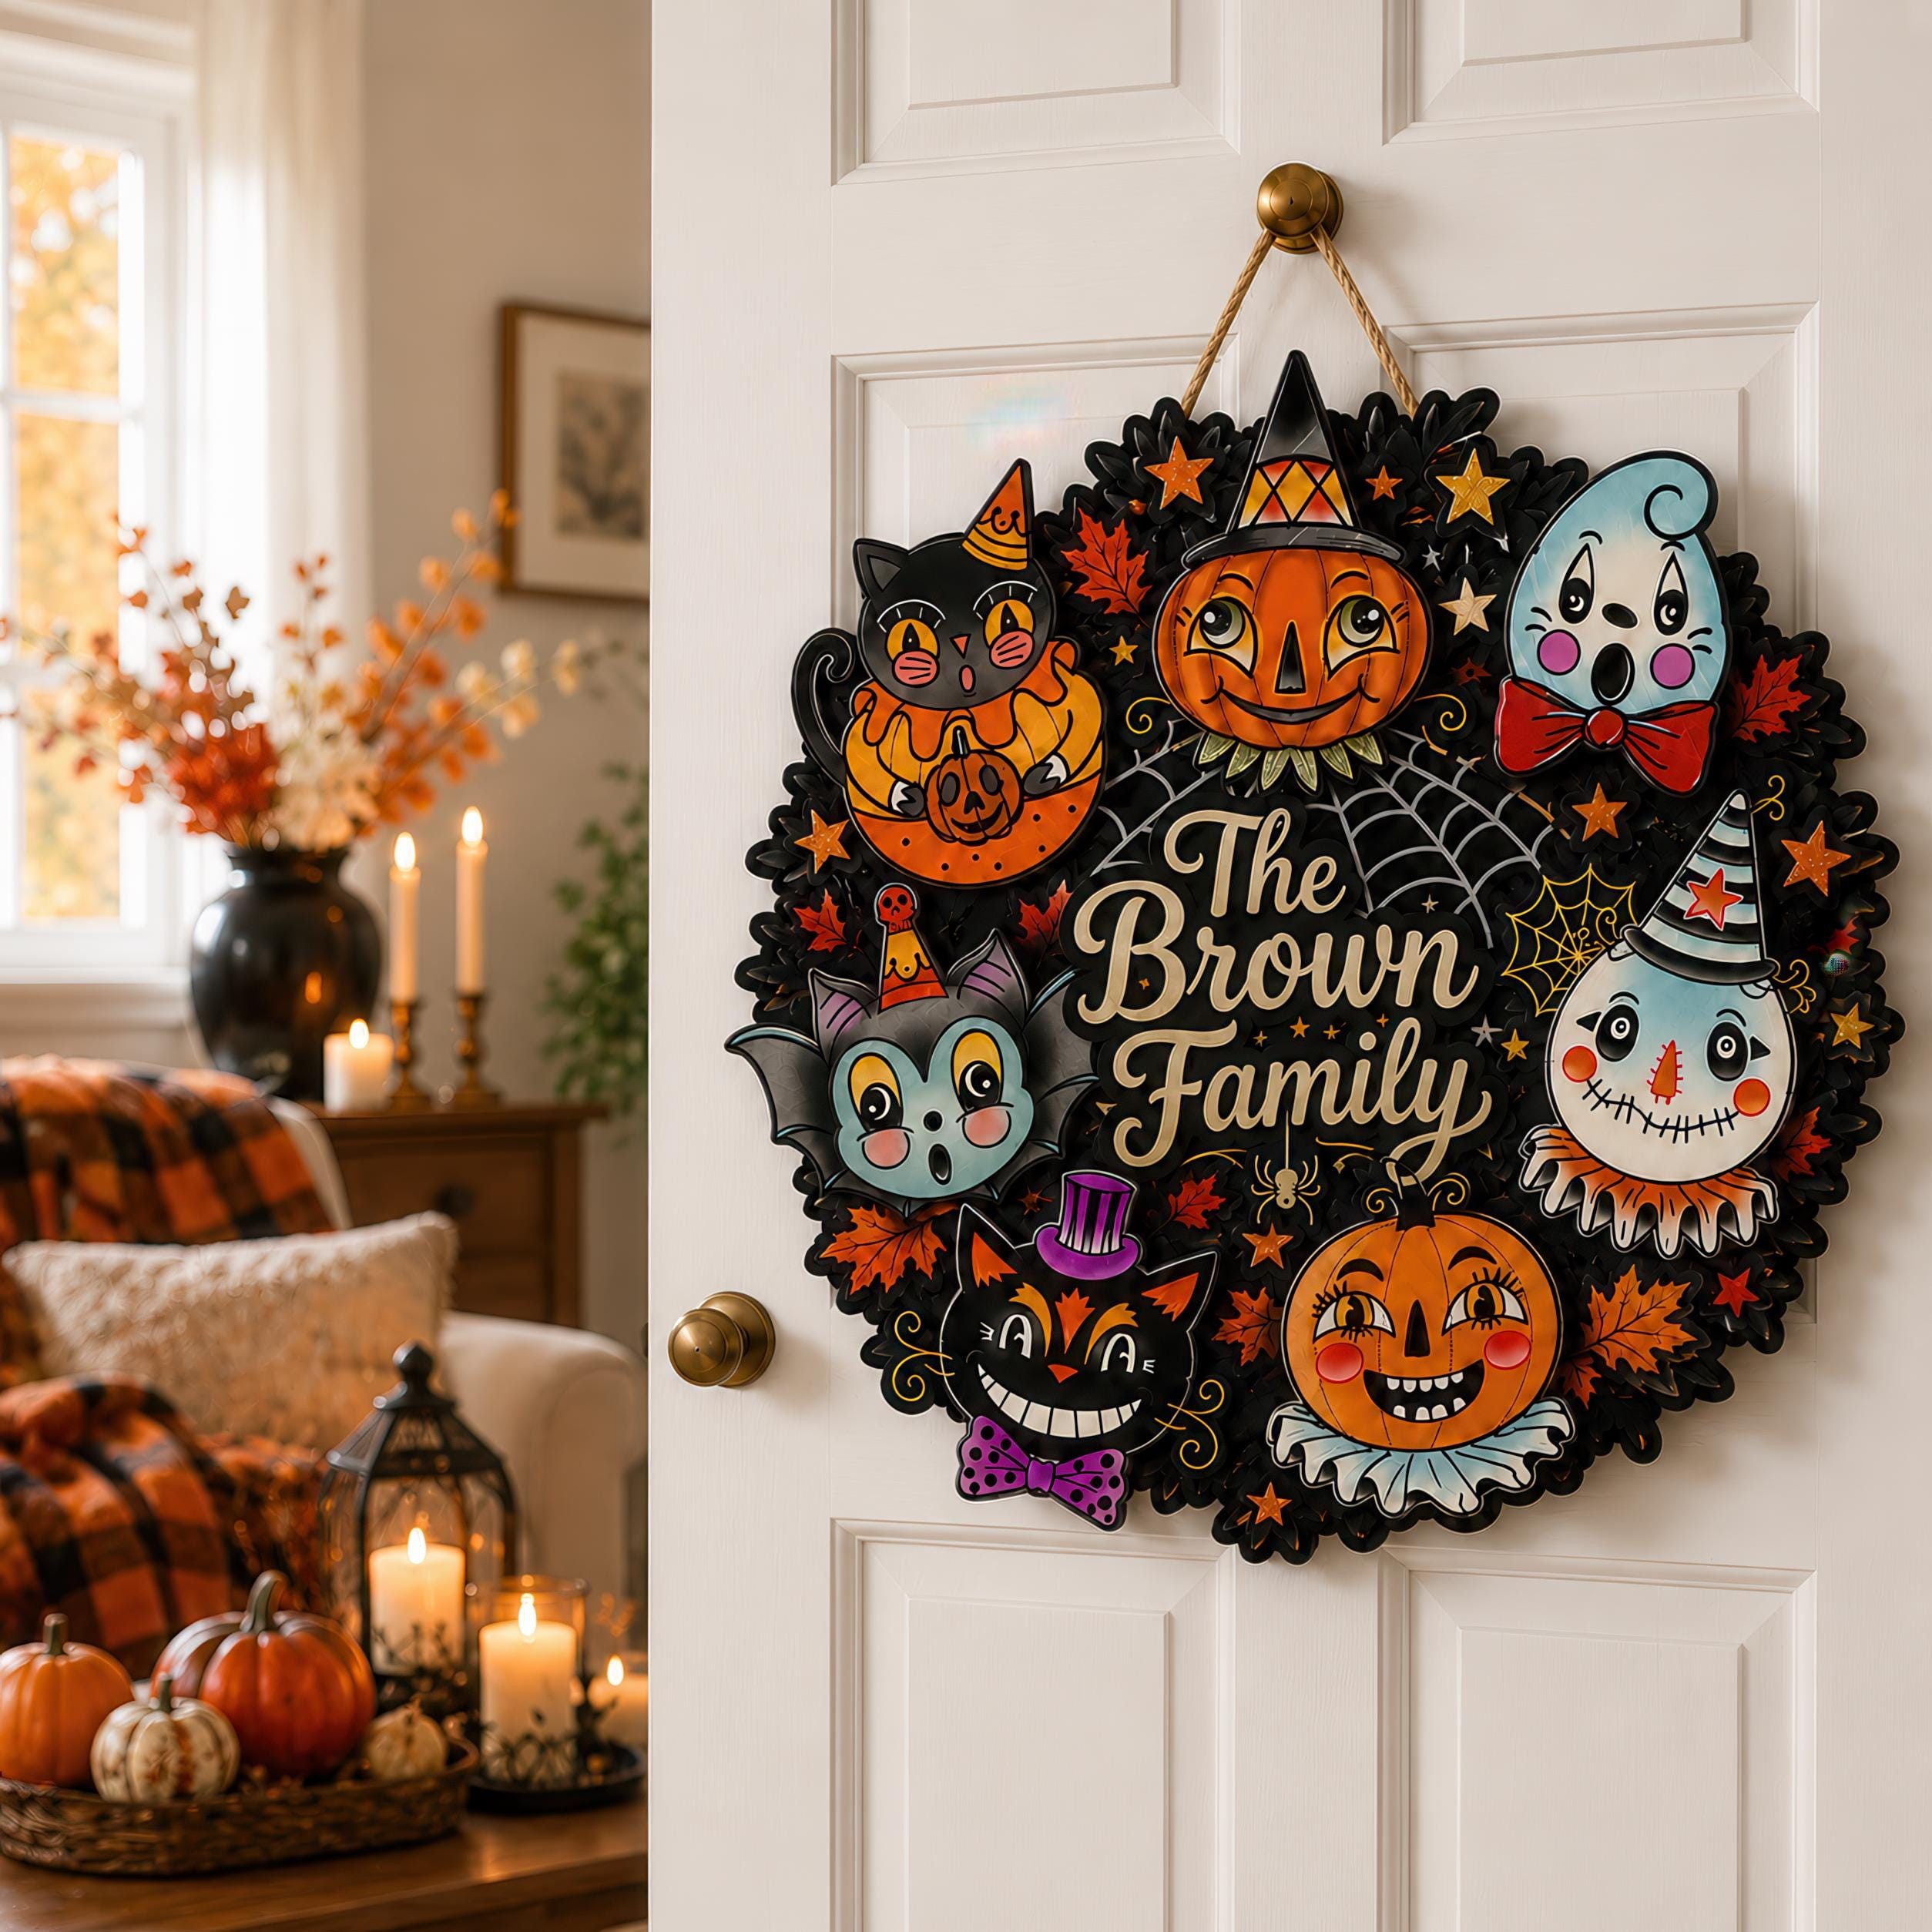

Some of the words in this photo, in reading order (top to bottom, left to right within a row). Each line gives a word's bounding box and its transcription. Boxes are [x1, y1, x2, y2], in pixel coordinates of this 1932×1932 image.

[1163, 807, 1347, 918] The
[1073, 880, 1479, 1025] Brown
[1112, 1017, 1493, 1186] Family
